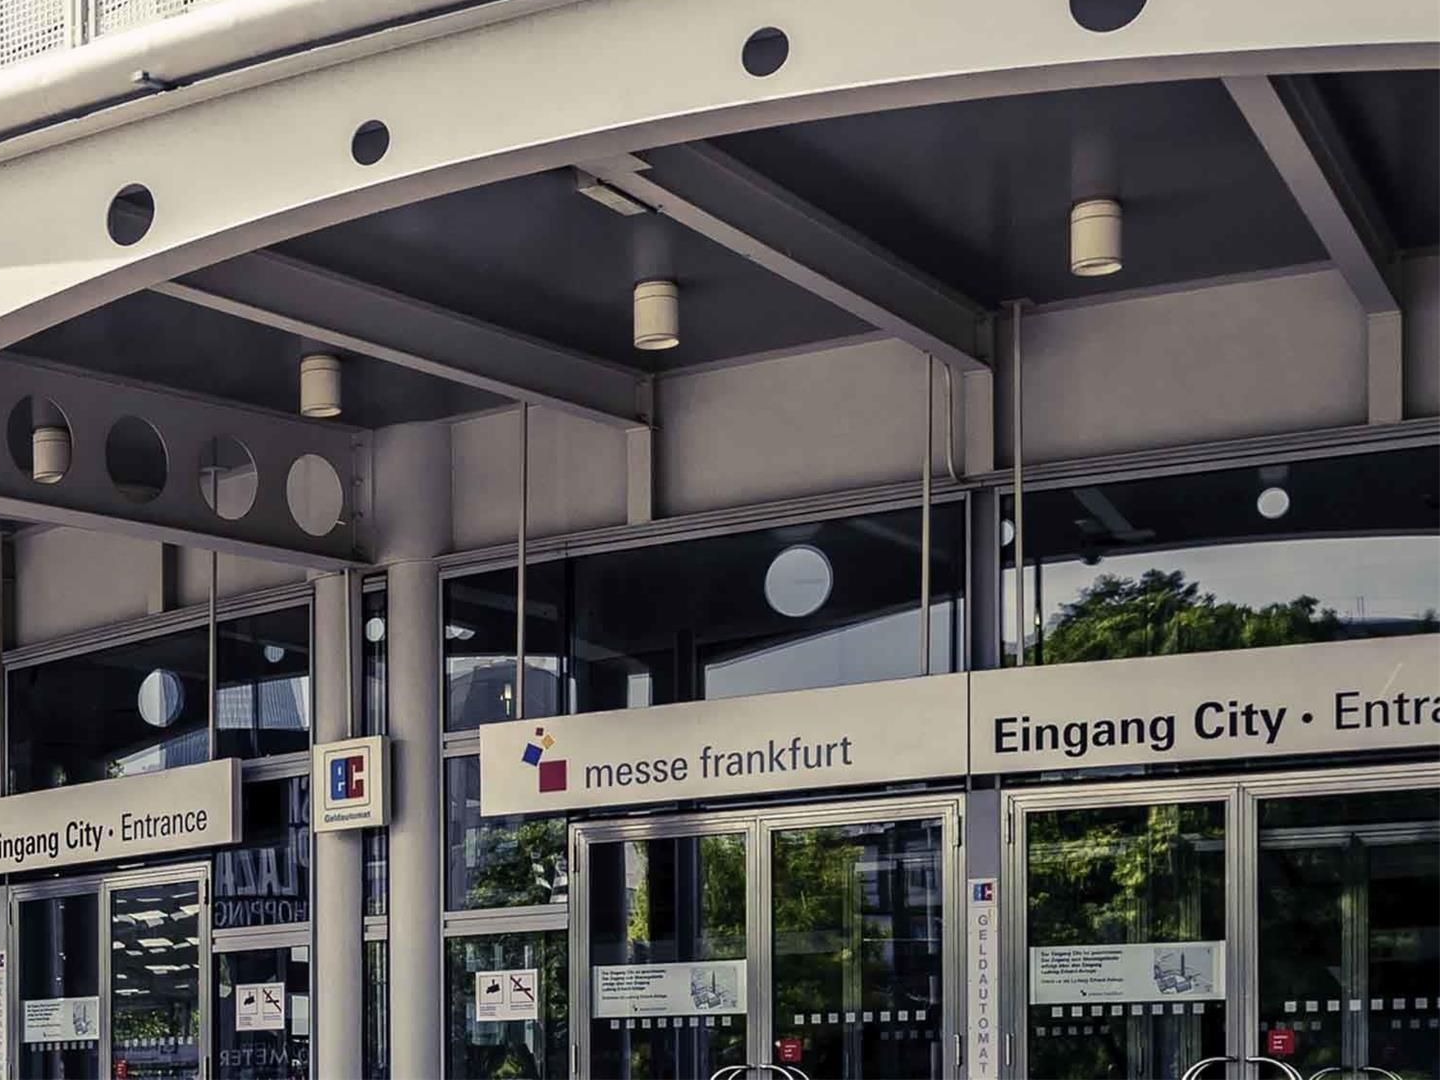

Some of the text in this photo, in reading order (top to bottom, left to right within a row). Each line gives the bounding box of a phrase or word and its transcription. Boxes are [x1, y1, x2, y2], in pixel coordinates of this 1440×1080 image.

[994, 716, 1176, 757] Eingang
[1194, 701, 1287, 744] City
[585, 735, 853, 788] messe frankfurt
[66, 821, 104, 853] City
[121, 809, 208, 842] Entrance
[324, 811, 371, 823] Geldautomat
[977, 914, 990, 1074] GELDAUTOMAT
